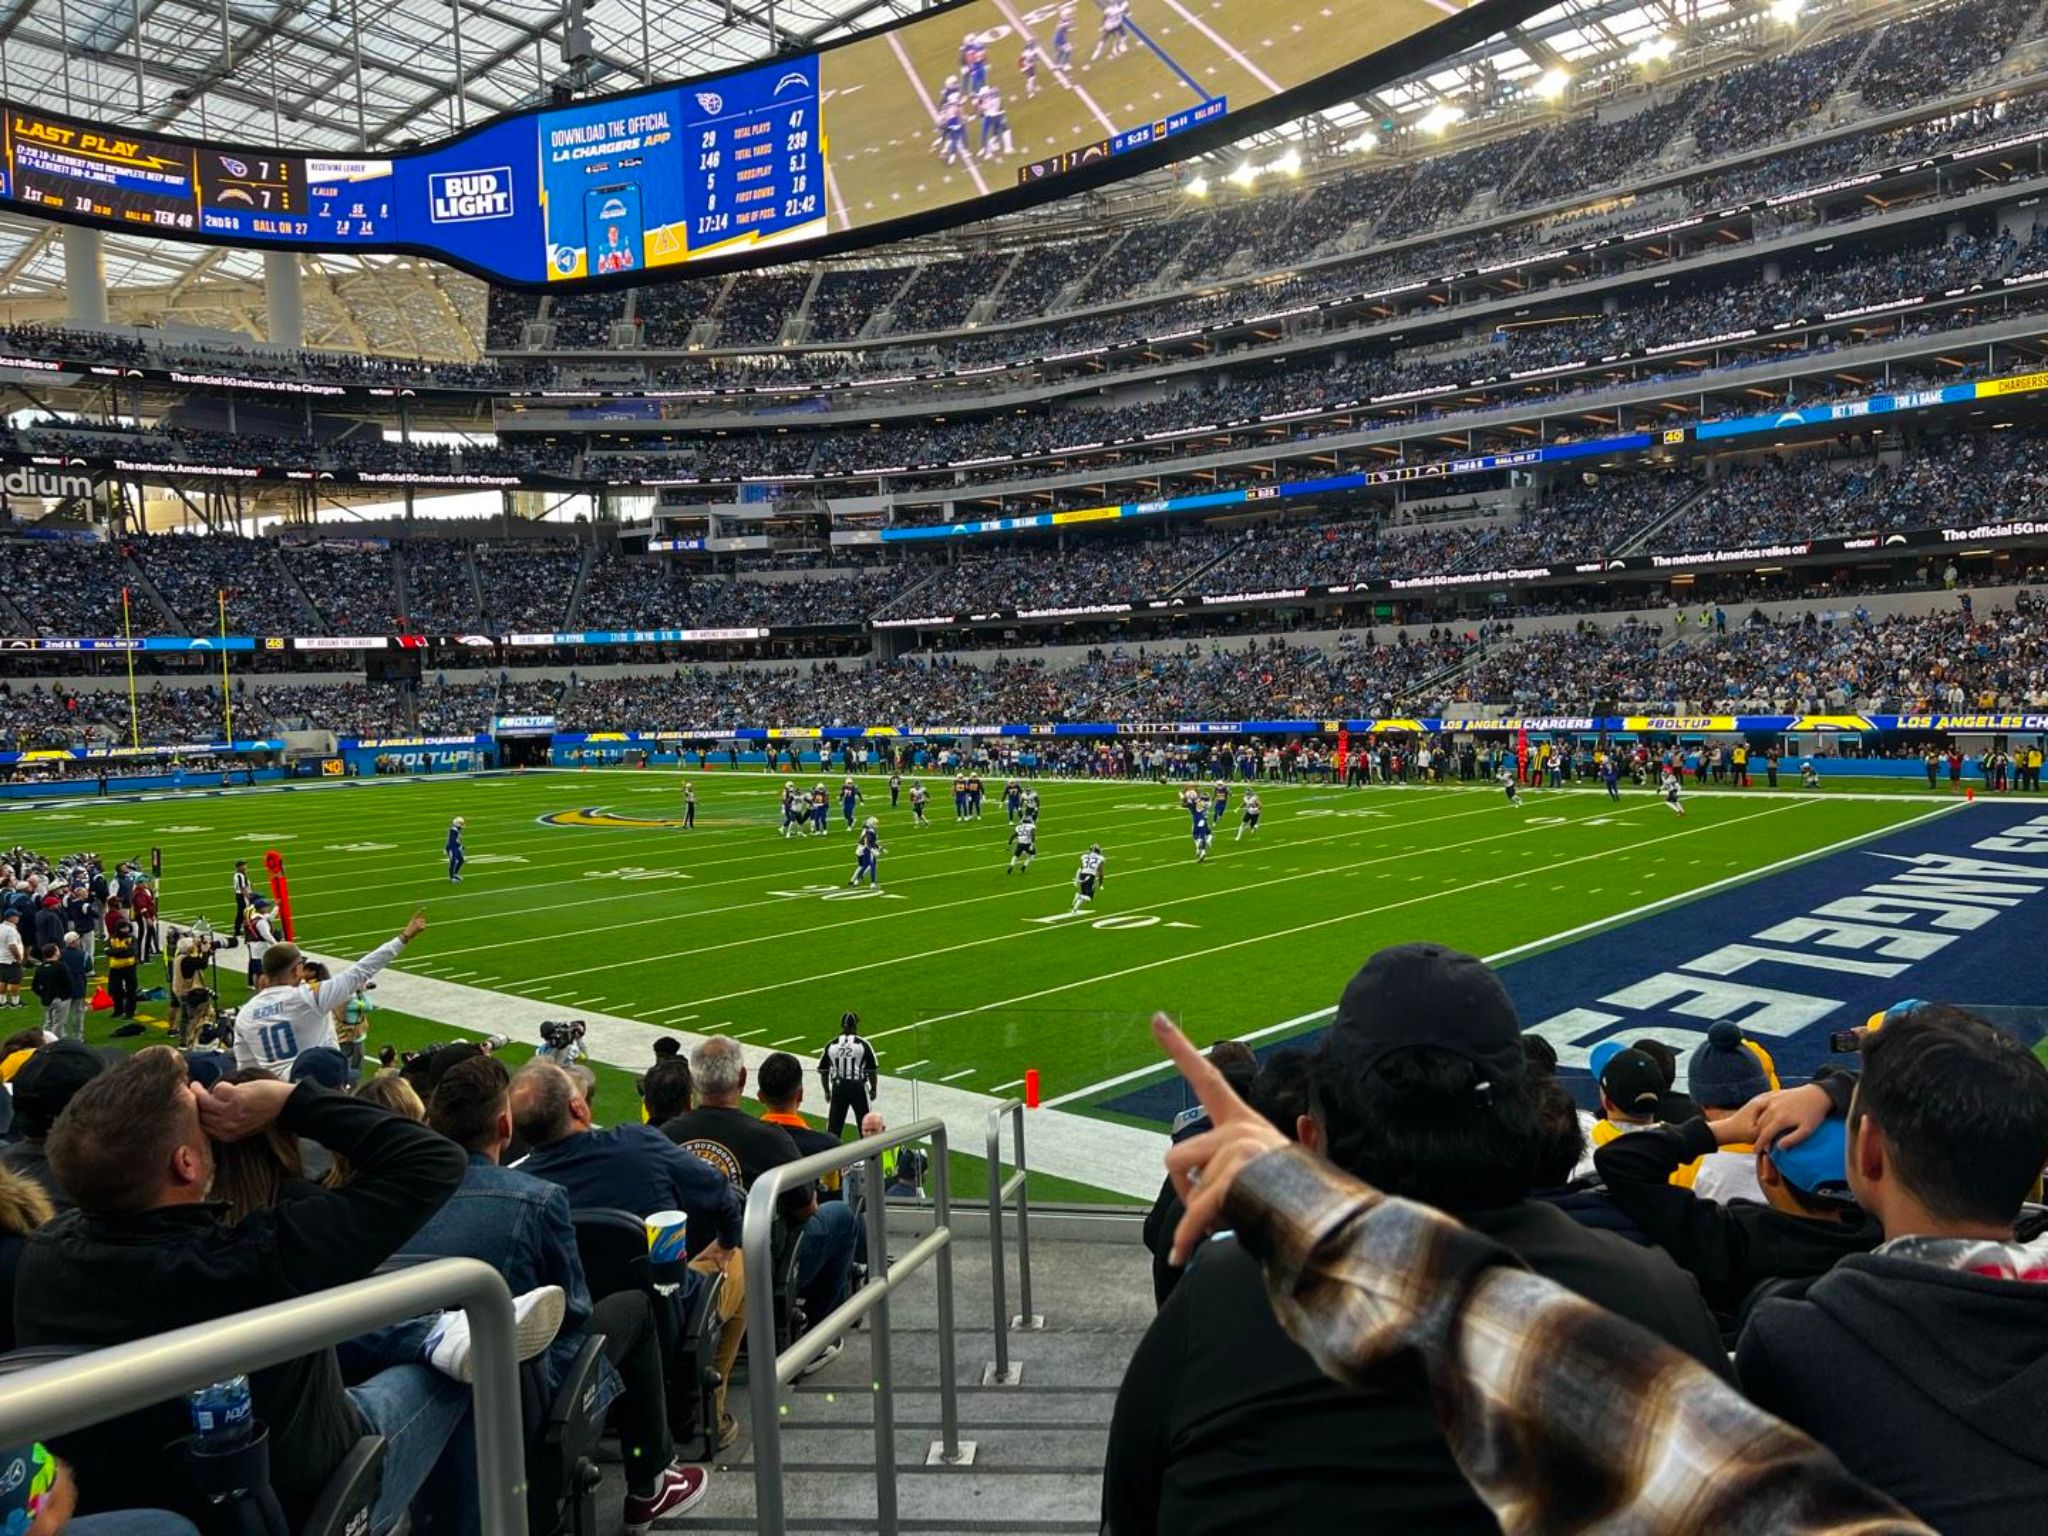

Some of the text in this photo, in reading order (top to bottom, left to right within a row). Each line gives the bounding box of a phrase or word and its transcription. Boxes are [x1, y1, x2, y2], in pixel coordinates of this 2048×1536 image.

[789, 110, 804, 128] 47
[15, 118, 140, 157] LAST PLAY
[552, 111, 670, 148] DOWNLOAD THE OFFICIAL
[1128, 129, 1148, 144] 5:25
[553, 132, 670, 163] LA CHARGERS APP
[702, 130, 716, 148] 29
[787, 130, 807, 151] 239
[700, 151, 720, 170] 146
[789, 153, 806, 172] 5.1
[259, 162, 268, 180] 7
[445, 175, 497, 198] BUD
[707, 173, 715, 190] 5
[792, 175, 806, 194] 16
[24, 186, 42, 202] 1ST
[76, 195, 91, 212] 10
[154, 209, 175, 225] TEN
[178, 213, 192, 228] 48
[261, 191, 270, 209] 7
[435, 192, 507, 217] LIGHT
[784, 195, 816, 217] 21:42
[253, 219, 308, 234] BALL ON 27
[698, 213, 728, 234] 17:14
[170, 372, 345, 396] The official 5G network of the Chargers.
[1894, 396, 1909, 409] FOR
[1919, 391, 1943, 406] GAME
[1665, 431, 1683, 442] 40
[114, 461, 257, 477] The network America relies on
[358, 472, 520, 485] The official 5G network of the Chargers.
[1942, 521, 2034, 543] The official 5G
[1844, 537, 1875, 549] verizon
[1652, 544, 1806, 567] The network America relies on
[1391, 566, 1550, 588] The official 5G network of the Chargers.
[909, 726, 1002, 735] LOS ANGELES CHARGERS
[1440, 718, 1593, 731] LOS ANGELES CHARGERS
[1646, 718, 1711, 729] #BOLTUP
[1897, 716, 2048, 728] LOS ANGELES CH
[358, 736, 476, 748] LOS ANGELES CHARGERS
[639, 730, 736, 740] LOS ANGELES CHARGERS
[87, 748, 107, 758] LOS
[325, 760, 342, 774] 40
[1083, 857, 1098, 868] 32
[258, 1020, 298, 1062] 10
[838, 1047, 853, 1058] 72
